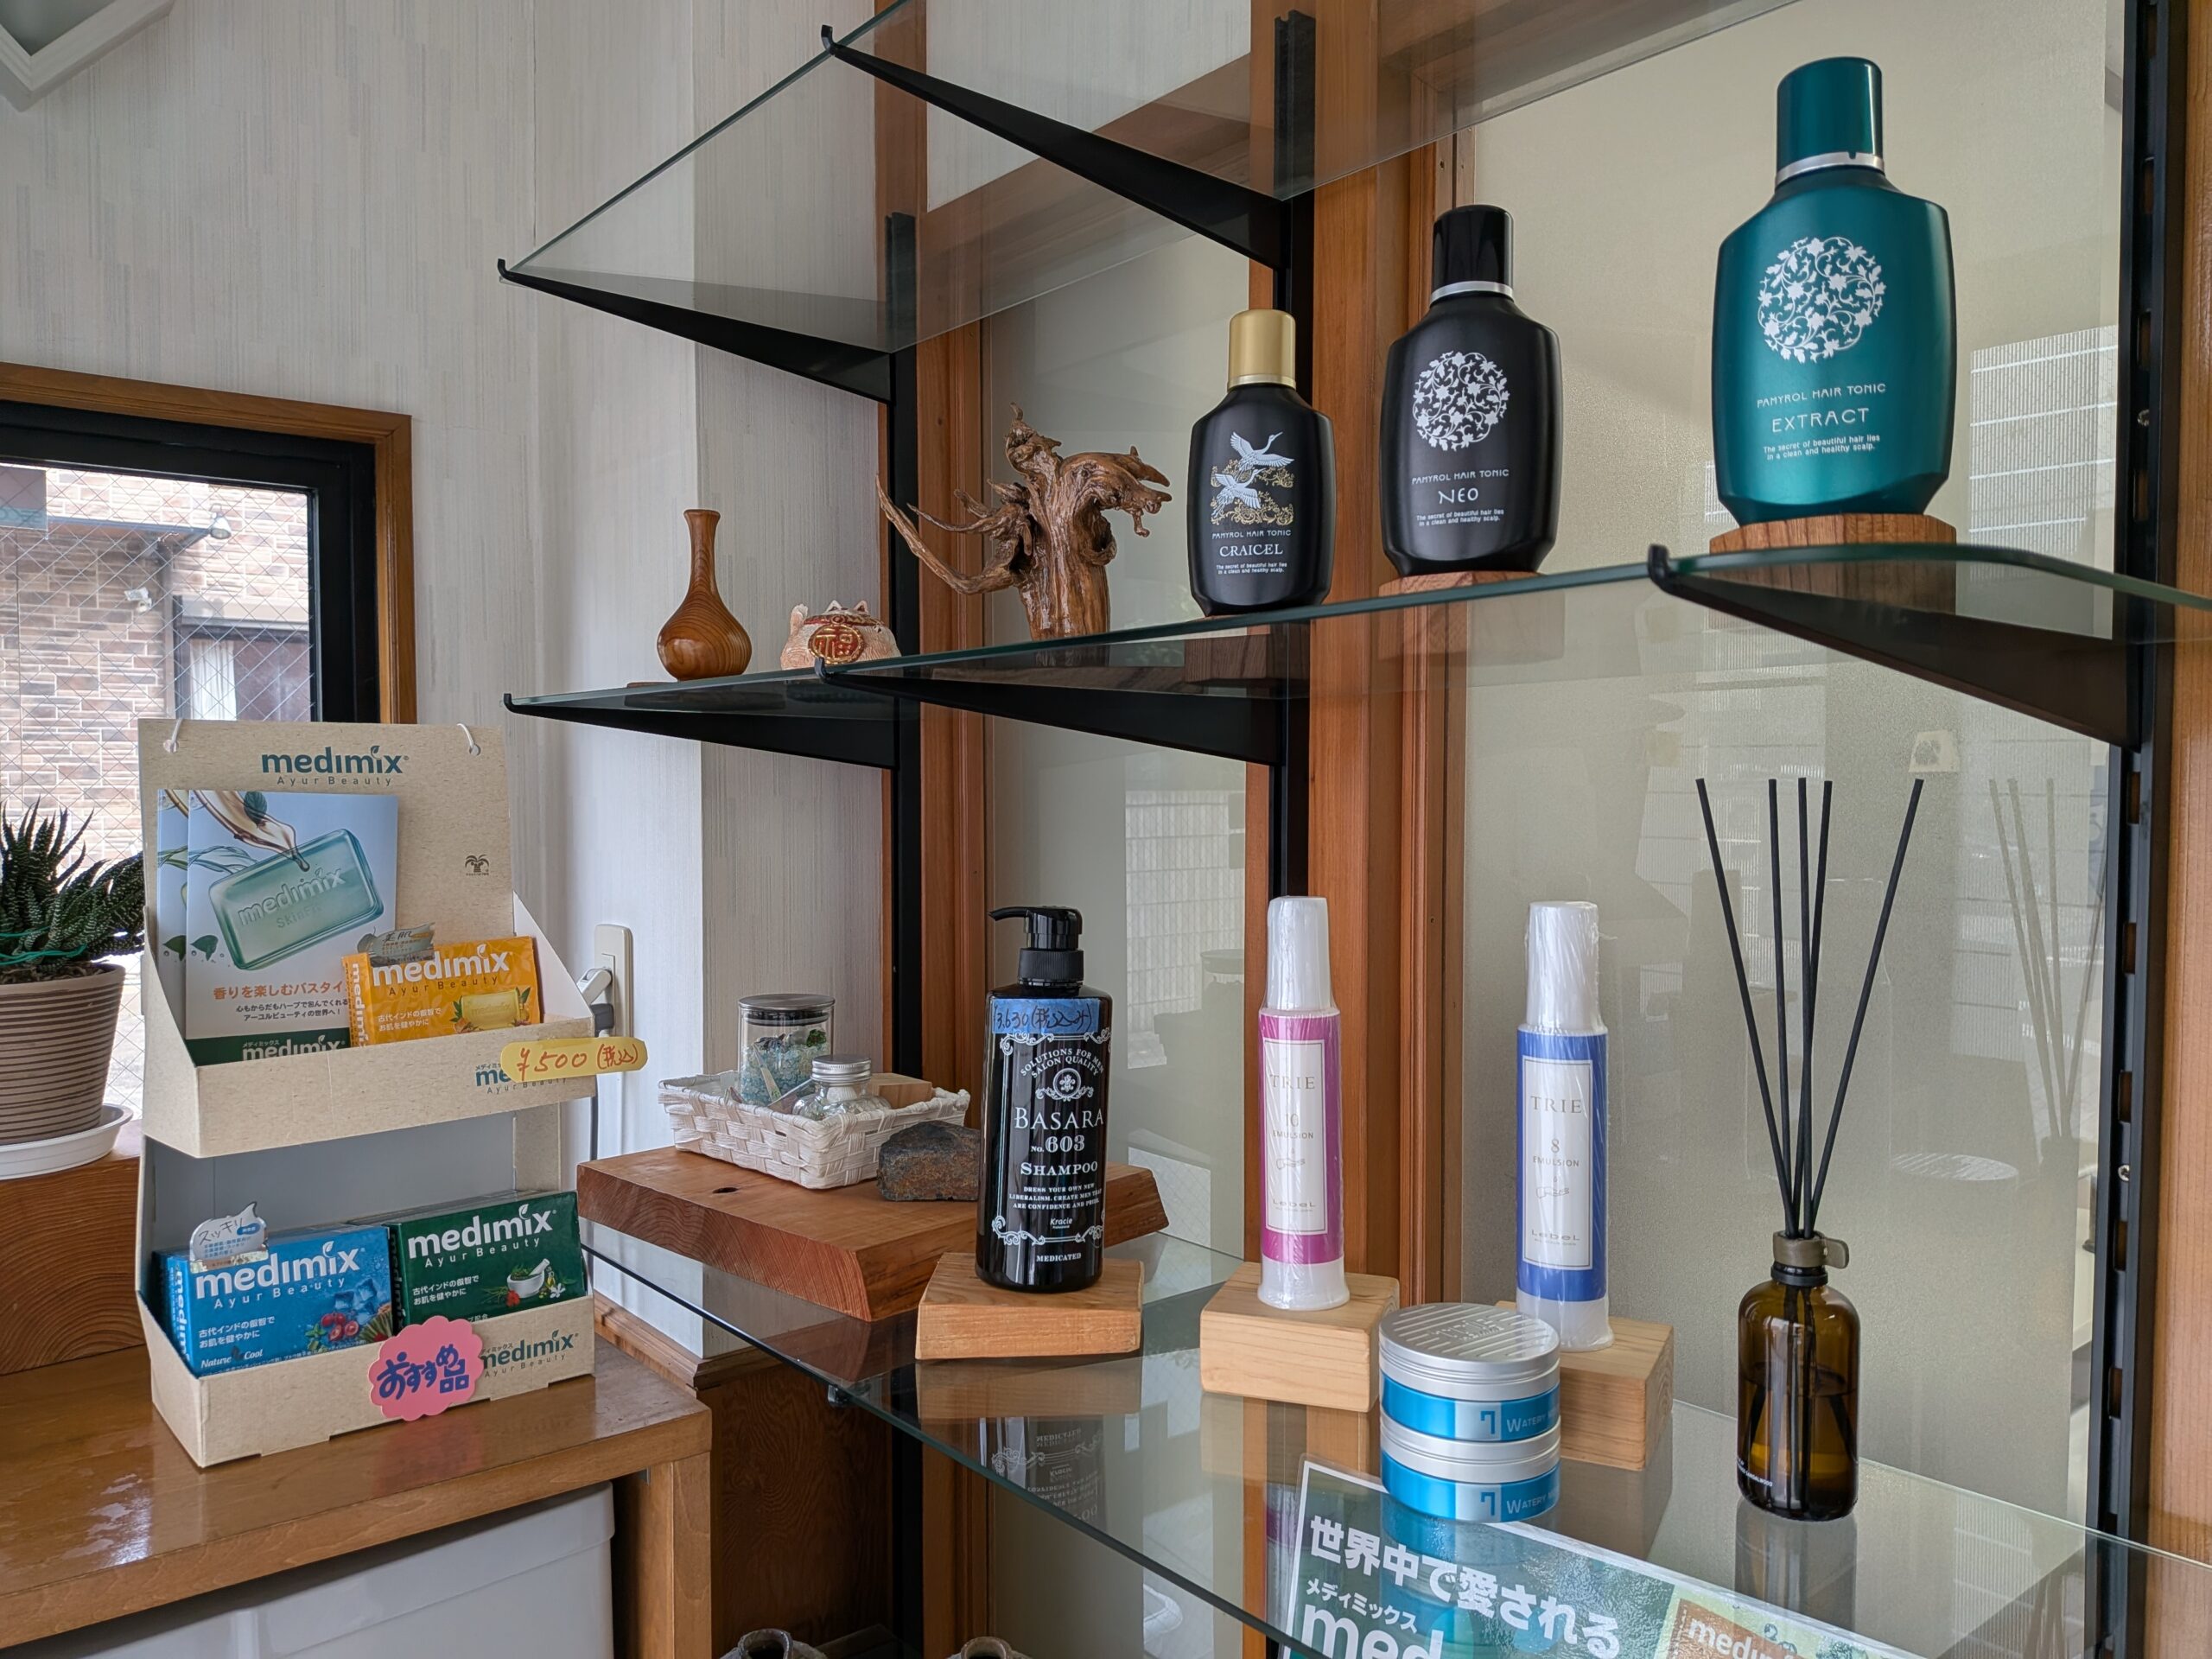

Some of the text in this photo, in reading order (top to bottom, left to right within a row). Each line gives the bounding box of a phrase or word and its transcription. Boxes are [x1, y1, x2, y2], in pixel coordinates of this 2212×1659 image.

[1812, 386, 1842, 400] HAIR
[1847, 383, 1886, 396] TONIC
[1772, 407, 1869, 433] EXTRACT
[1764, 446, 1776, 454] The
[1778, 442, 1801, 451] secret
[1813, 436, 1847, 447] beautiful
[1849, 435, 1864, 443] hair
[1866, 434, 1880, 442] lies
[1783, 449, 1802, 458] clean
[1821, 444, 1850, 454] healthy
[1853, 442, 1875, 453] scalp.
[1454, 471, 1477, 480] HAIR
[1479, 469, 1510, 478] TONIC
[1438, 487, 1479, 504] NEO
[1219, 543, 1284, 557] CRAICEL
[262, 746, 403, 773] medimix
[276, 776, 392, 787] Ayur Beauty
[238, 868, 346, 926] medimix
[372, 944, 510, 987] medimix
[213, 982, 347, 1000] 香りを楽しむバスタイ
[389, 976, 499, 996] Ayur Beauty
[378, 1018, 429, 1032] お肌を健やかに
[243, 1039, 280, 1048] メディミックス
[517, 1047, 588, 1082] ¥500
[1020, 1048, 1104, 1076] SOLUTIONS FOR MEN
[1031, 1055, 1099, 1078] SALON QUALITY
[487, 1084, 516, 1095] Ayur
[1269, 1074, 1316, 1090] TRIE
[1530, 1096, 1582, 1114] TRIE
[1014, 1106, 1104, 1130] BASARA
[1285, 1113, 1300, 1127] 10
[1273, 1129, 1313, 1139] EMULSION
[1551, 1138, 1560, 1154] 8
[1533, 1155, 1580, 1167] EMULSION
[407, 1204, 554, 1259] medimix
[425, 1237, 540, 1268] Ayur Beauty
[1037, 1252, 1082, 1262] MEDICATED
[195, 1241, 360, 1300] medimix
[213, 1277, 345, 1309] Ayur Beauty
[412, 1275, 480, 1296] 古代インドの叡智で
[413, 1288, 467, 1306] お肌を健やかに
[198, 1316, 276, 1338] 古代インドの叡智で
[199, 1330, 260, 1349] お肌を健やかに
[200, 1350, 264, 1369] Nature Cool
[485, 1353, 565, 1378] Ayur Beauty
[376, 1343, 469, 1401] おすすめ品
[1310, 1516, 1621, 1658] 世界中で愛される
[1306, 1577, 1418, 1634] メディミックス
